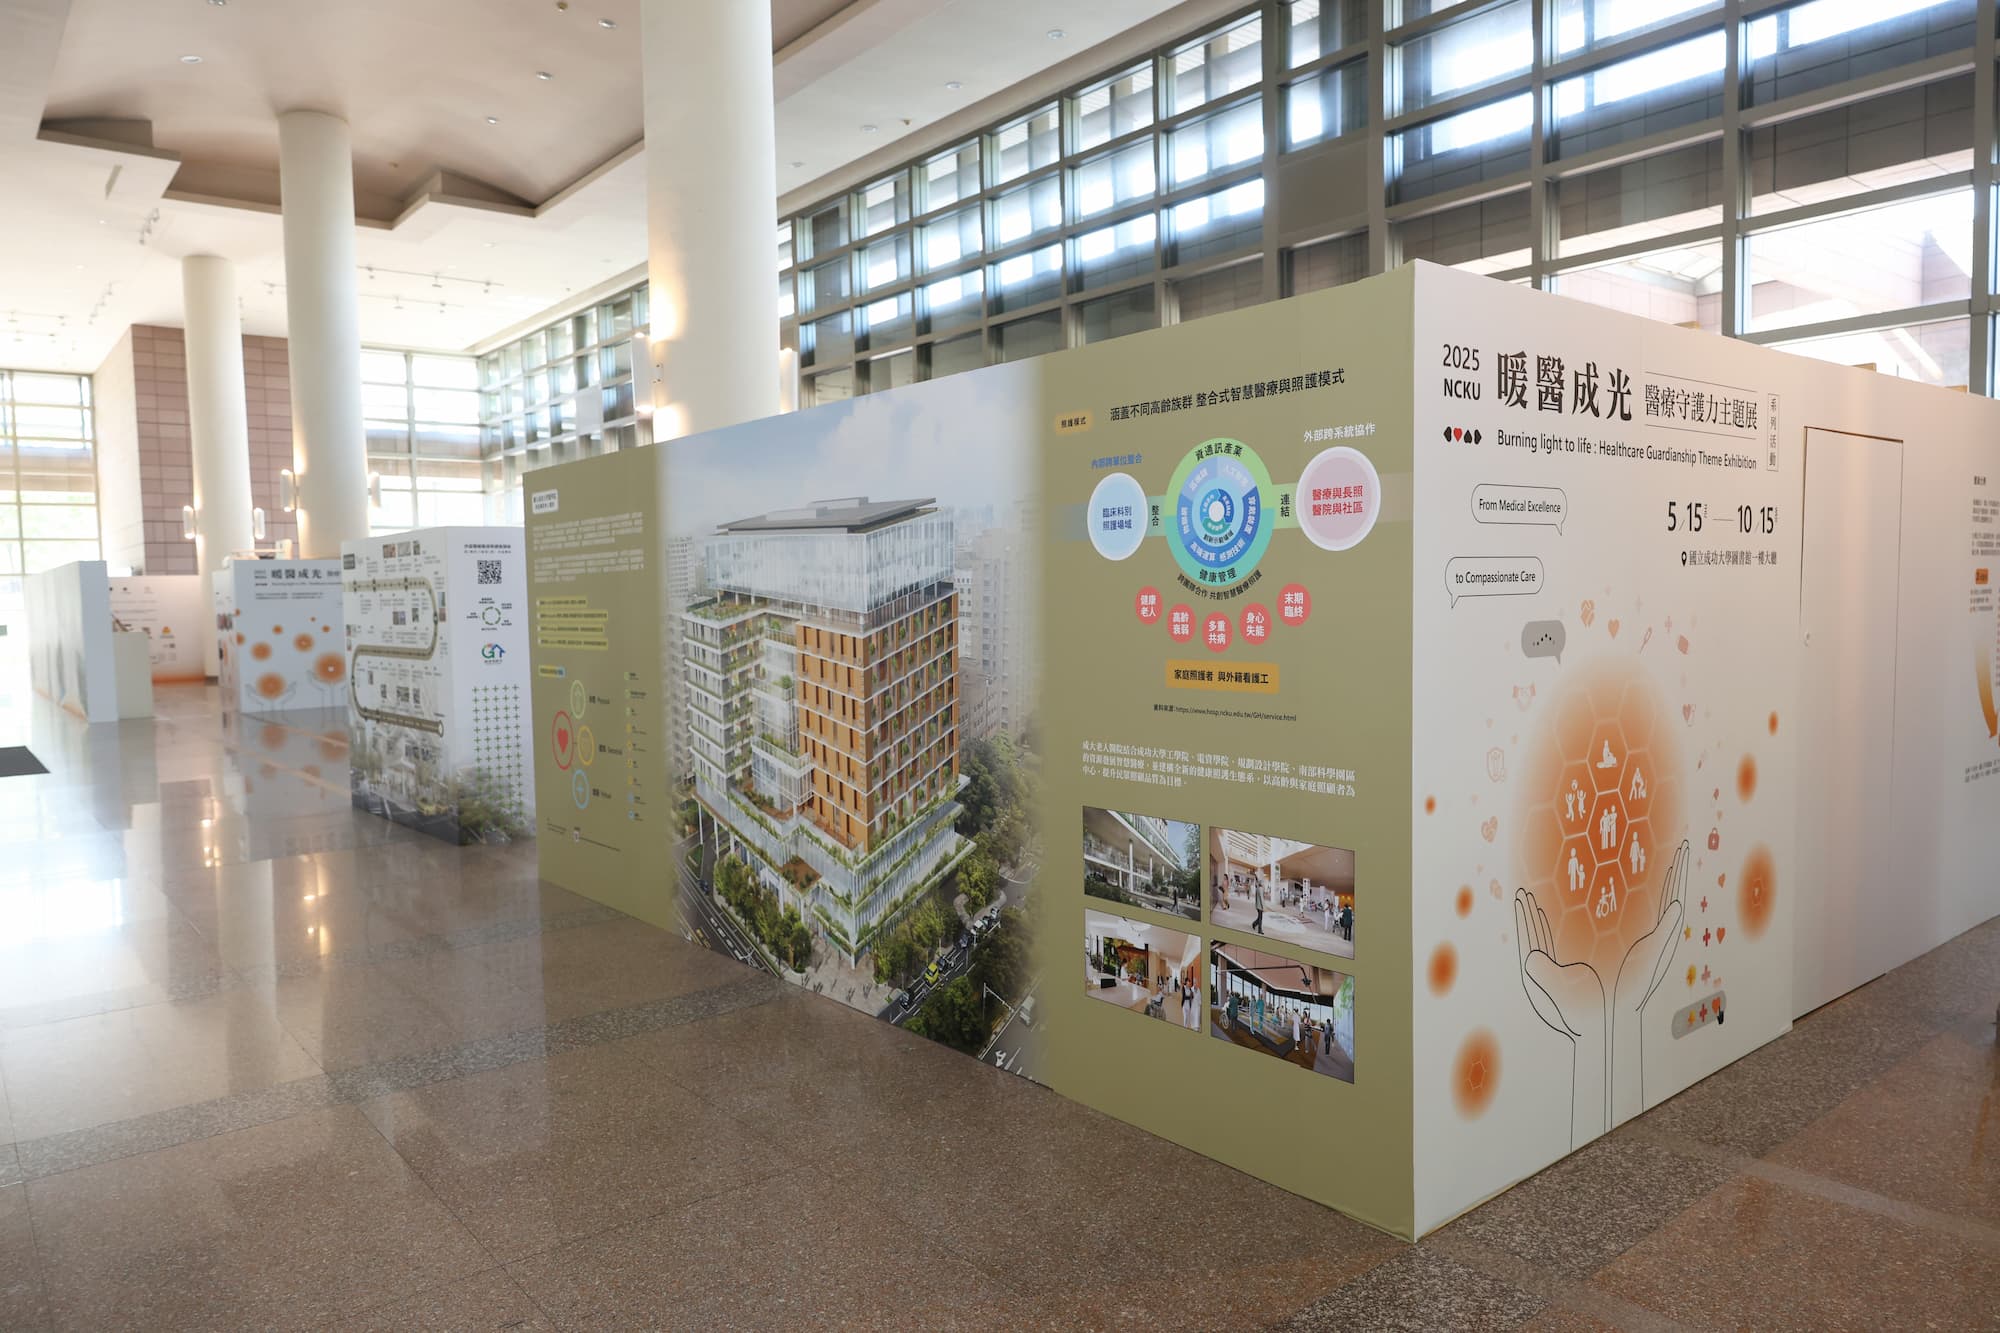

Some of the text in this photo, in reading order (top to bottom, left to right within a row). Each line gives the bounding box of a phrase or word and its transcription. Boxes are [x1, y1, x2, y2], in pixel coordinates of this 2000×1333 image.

[1443, 343, 1480, 371] 2025
[1444, 378, 1481, 401] NCKU
[1497, 350, 1632, 422] 暖醫成光
[1110, 368, 1345, 421] 涵蓋不同高齡族群 整合式智慧醫療與照護模式
[1645, 384, 1758, 430] 醫療守護力主題展
[1304, 423, 1376, 442] 外部跨系統協作
[1498, 429, 1537, 453] Burning
[1541, 433, 1562, 454] light
[1565, 438, 1575, 452] to
[1578, 436, 1592, 453] life
[1600, 440, 1645, 460] Healthcare
[1647, 446, 1696, 467] Guardianship
[1699, 451, 1722, 466] Theme
[1724, 453, 1757, 469] Exhibition
[1312, 485, 1363, 501] 醫療與長照
[1280, 493, 1290, 518] 連結
[1312, 501, 1363, 516] 醫院與社區
[1479, 498, 1561, 513] From Medical Excellence
[1689, 549, 1777, 566] 國立成功大學圖書館一樓大廳
[1199, 567, 1237, 583] 健康管理
[1455, 570, 1536, 587] to Compassionate Care
[1284, 592, 1303, 605] 末期
[1246, 612, 1264, 624] 身心
[1284, 605, 1303, 618] 臨終
[1208, 620, 1226, 632] 多重
[1246, 625, 1264, 637] 失能
[1208, 633, 1226, 645] 共病
[1174, 669, 1213, 682] 家庭照護者
